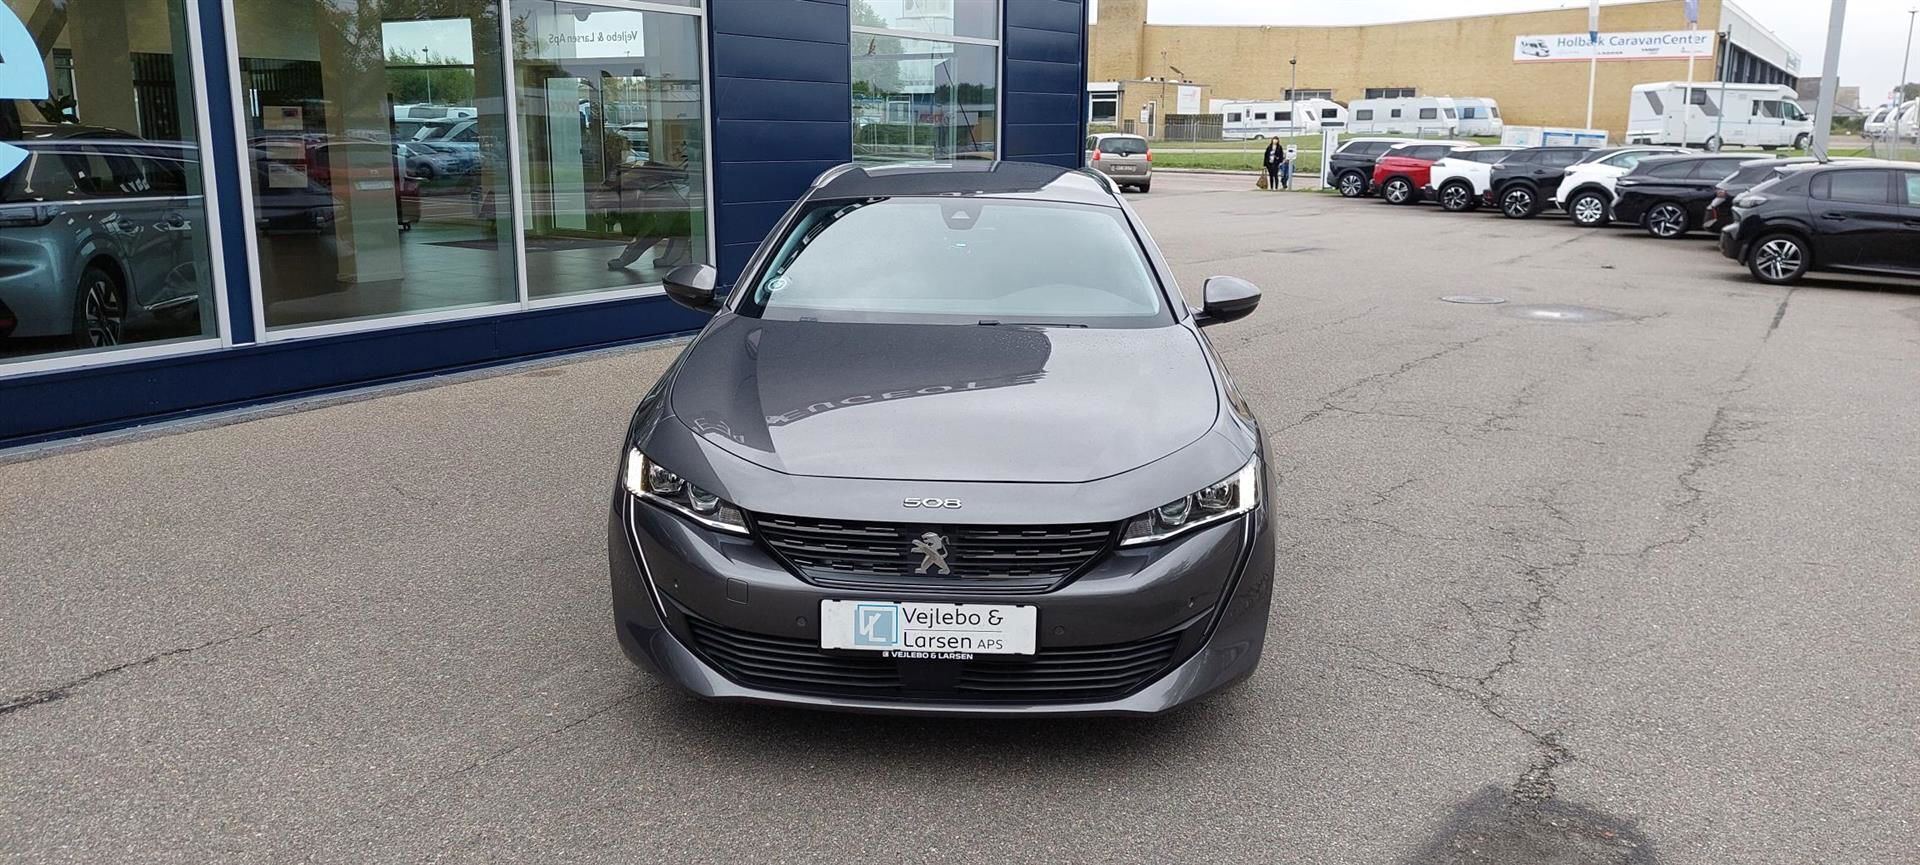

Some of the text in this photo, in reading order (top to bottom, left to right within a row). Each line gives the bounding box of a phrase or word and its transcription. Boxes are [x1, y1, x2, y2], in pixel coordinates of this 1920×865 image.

[1609, 34, 1707, 46] CaravanCenter
[903, 497, 962, 509] 508
[903, 608, 1004, 628] Vejlebo &
[904, 631, 1003, 650] Larsen APS
[891, 651, 929, 659] VEJLEBO
